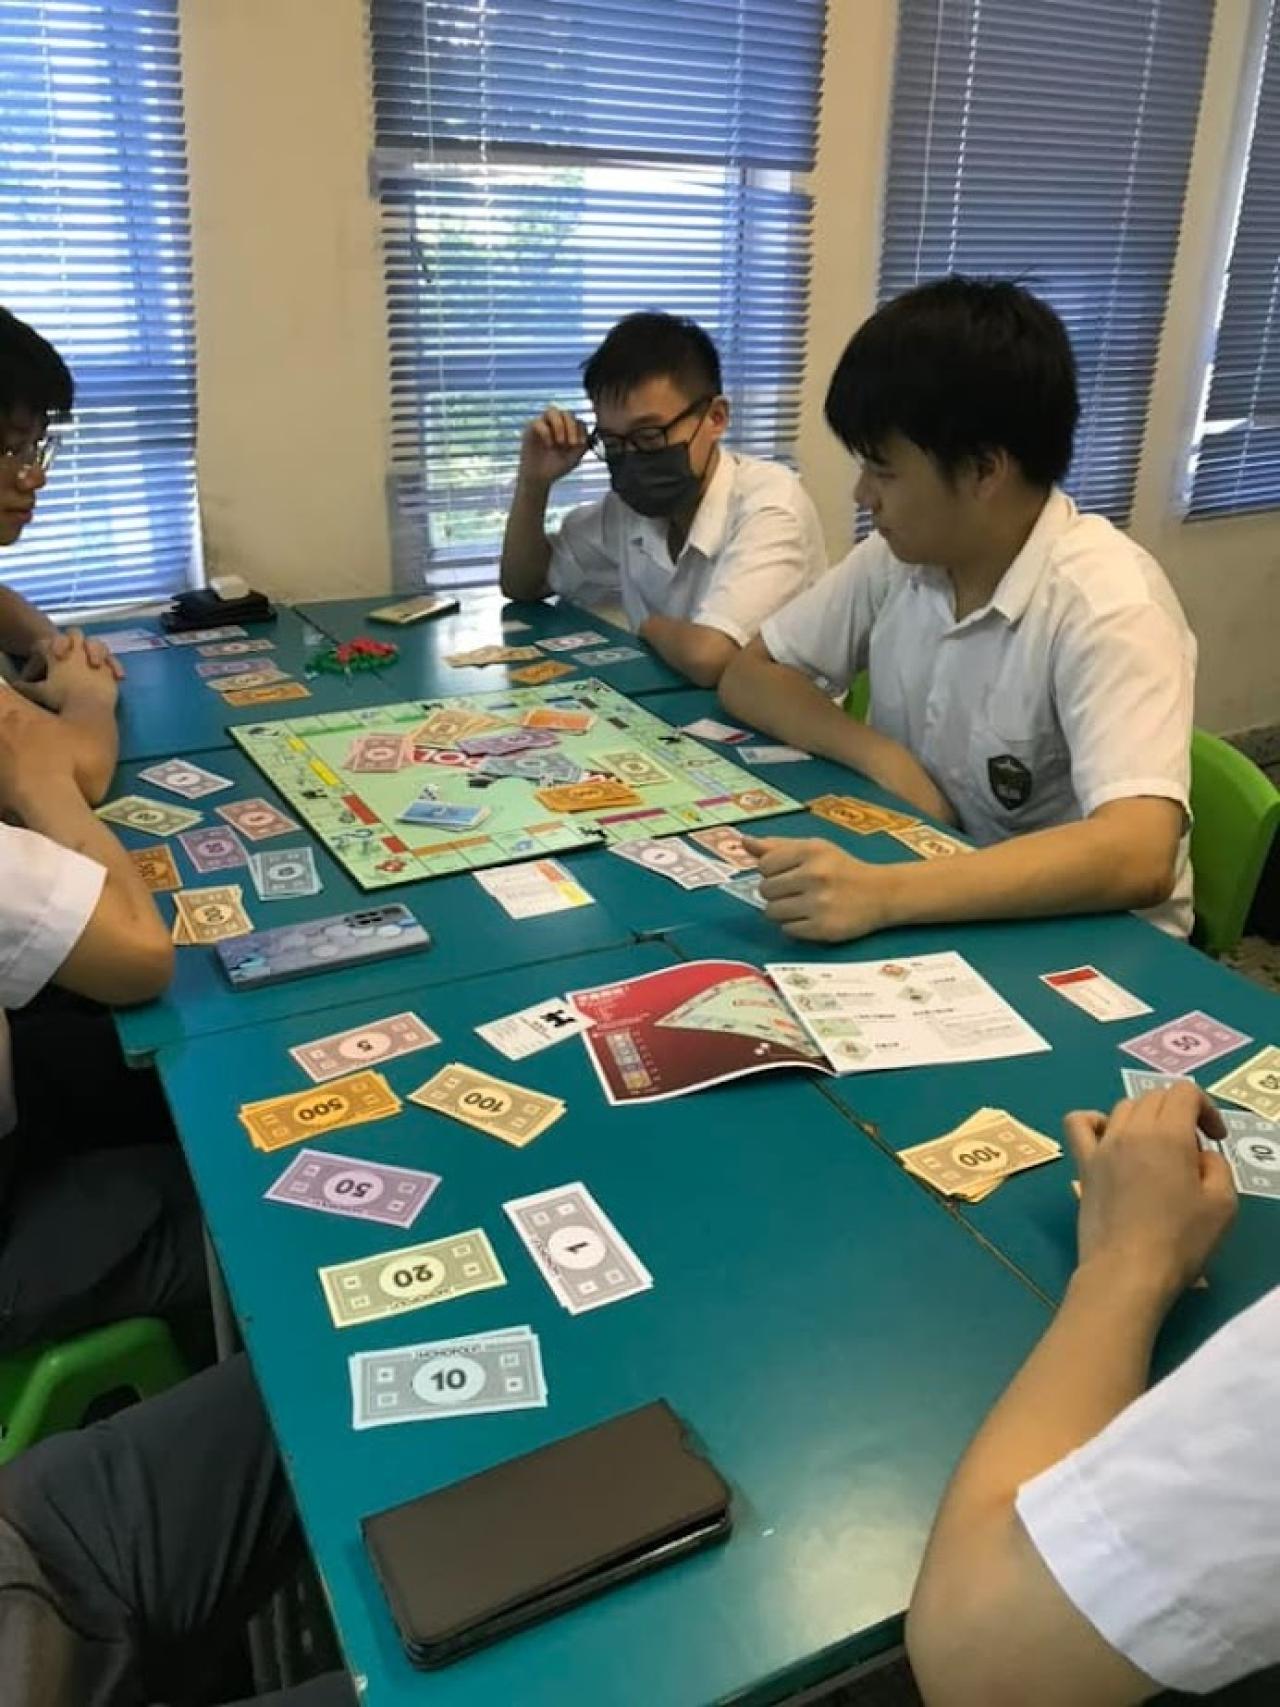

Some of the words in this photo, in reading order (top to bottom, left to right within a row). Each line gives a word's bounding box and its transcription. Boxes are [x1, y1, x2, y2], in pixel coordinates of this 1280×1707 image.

[357, 1039, 372, 1052] 5
[299, 1098, 344, 1121] 500
[463, 1092, 504, 1113] 100
[959, 1146, 1000, 1167] 100
[335, 1179, 373, 1198] 50
[566, 1241, 589, 1255] 1
[393, 1264, 434, 1288] 20
[430, 1368, 467, 1391] 10
